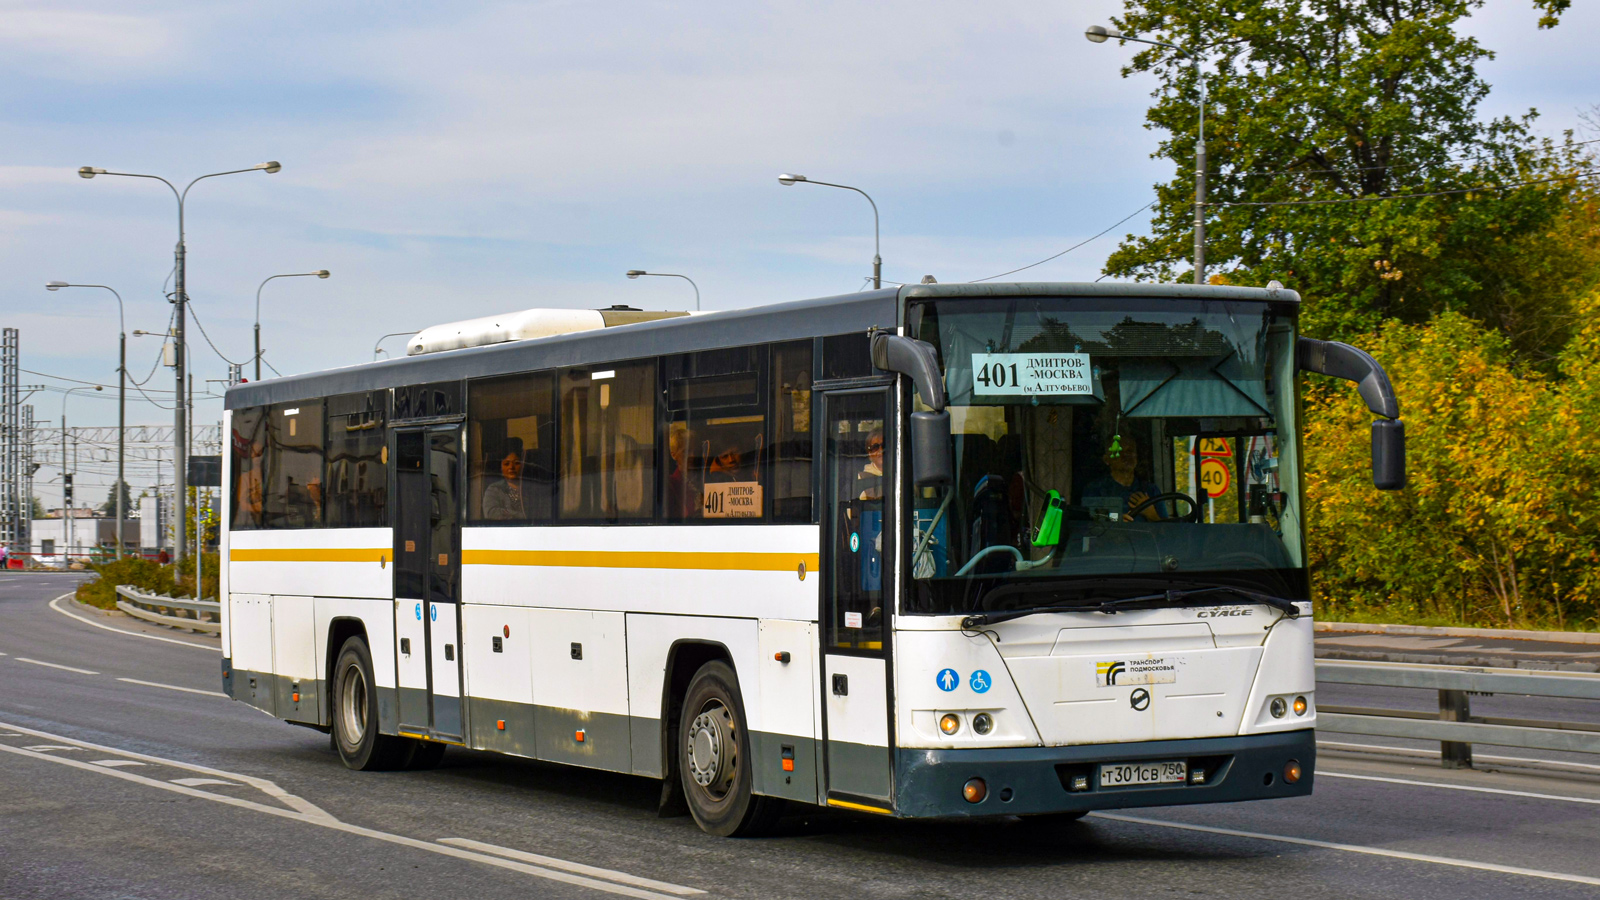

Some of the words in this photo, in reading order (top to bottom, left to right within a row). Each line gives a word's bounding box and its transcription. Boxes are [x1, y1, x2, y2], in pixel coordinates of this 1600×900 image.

[1026, 358, 1085, 369] ДМИТРОВ-
[977, 362, 1019, 388] 401
[1030, 369, 1083, 379] -МОСКВА
[1202, 470, 1223, 485] 40
[704, 491, 724, 514] 401
